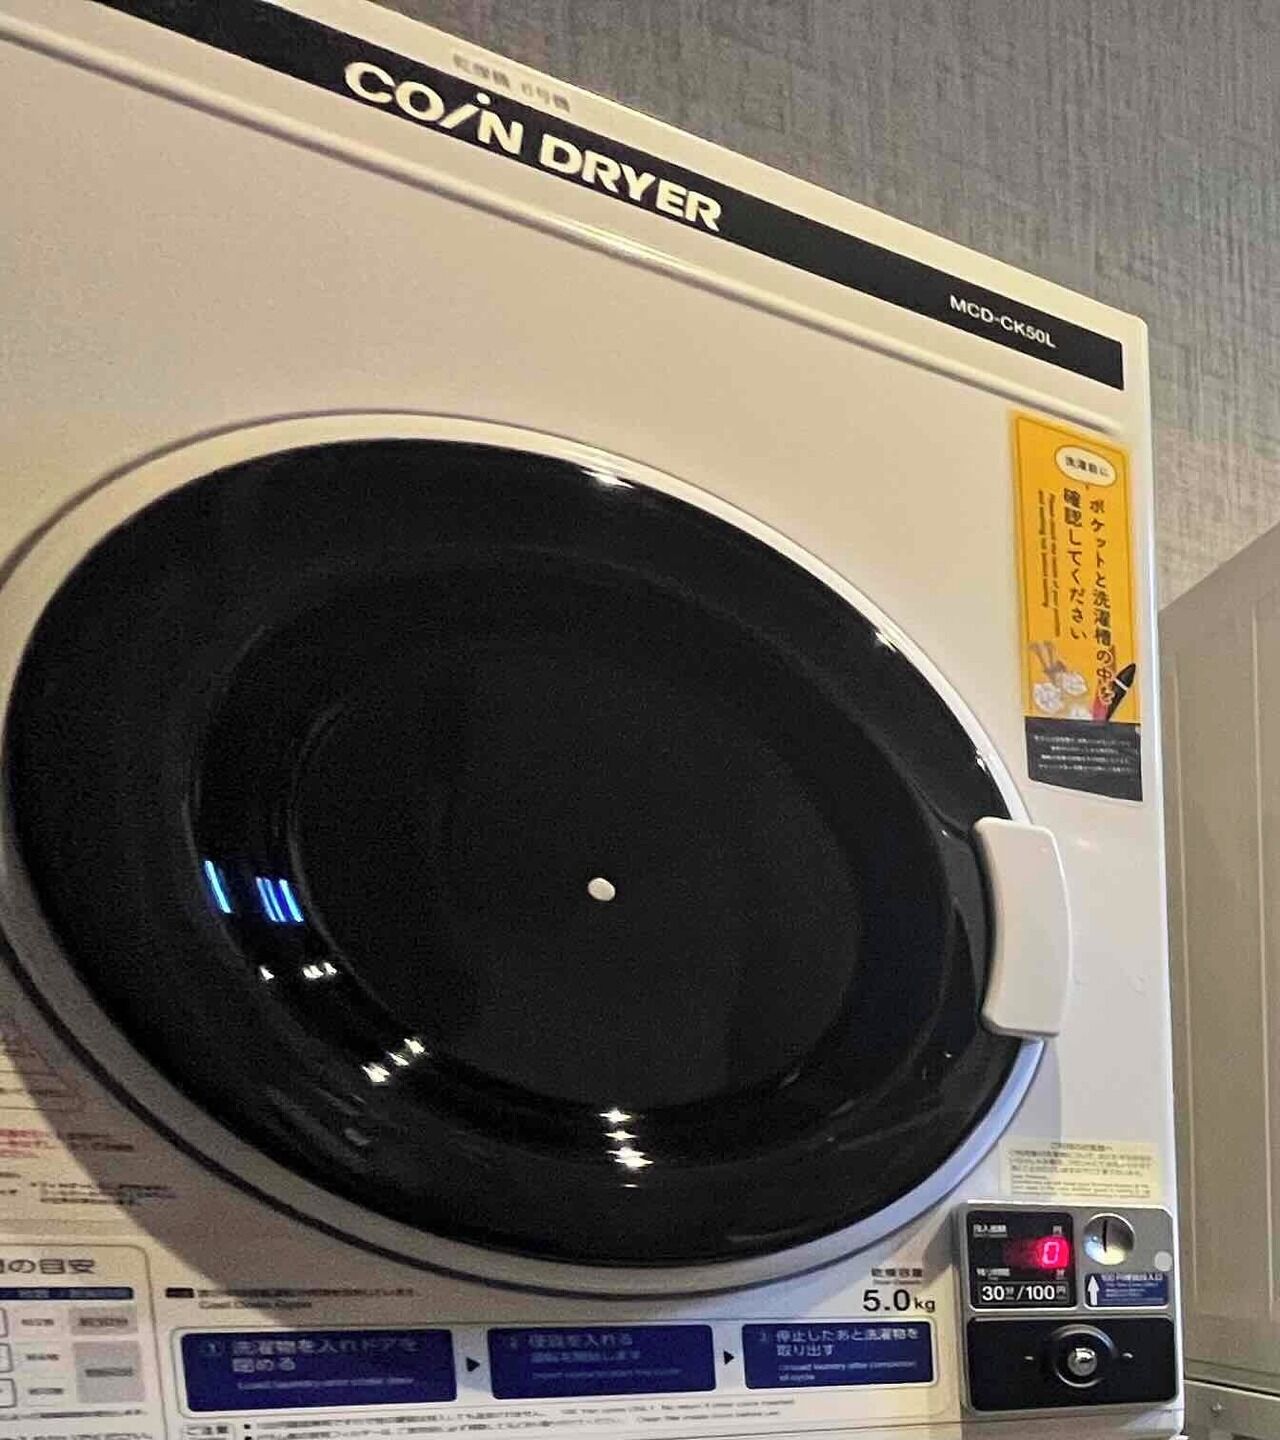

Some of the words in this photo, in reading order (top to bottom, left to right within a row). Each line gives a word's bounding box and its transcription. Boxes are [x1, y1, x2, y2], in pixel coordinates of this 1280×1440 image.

[539, 133, 722, 231] DRYER
[950, 295, 1056, 348] MCD-CK50L
[1063, 487, 1087, 640] 確認してください
[1042, 1241, 1060, 1265] 0
[0, 1257, 95, 1275] の目安
[863, 1289, 911, 1312] 5.0
[914, 1297, 936, 1313] kg
[776, 1327, 919, 1343] 停止したあと洗濯物を
[776, 1344, 834, 1357] 取り出す
